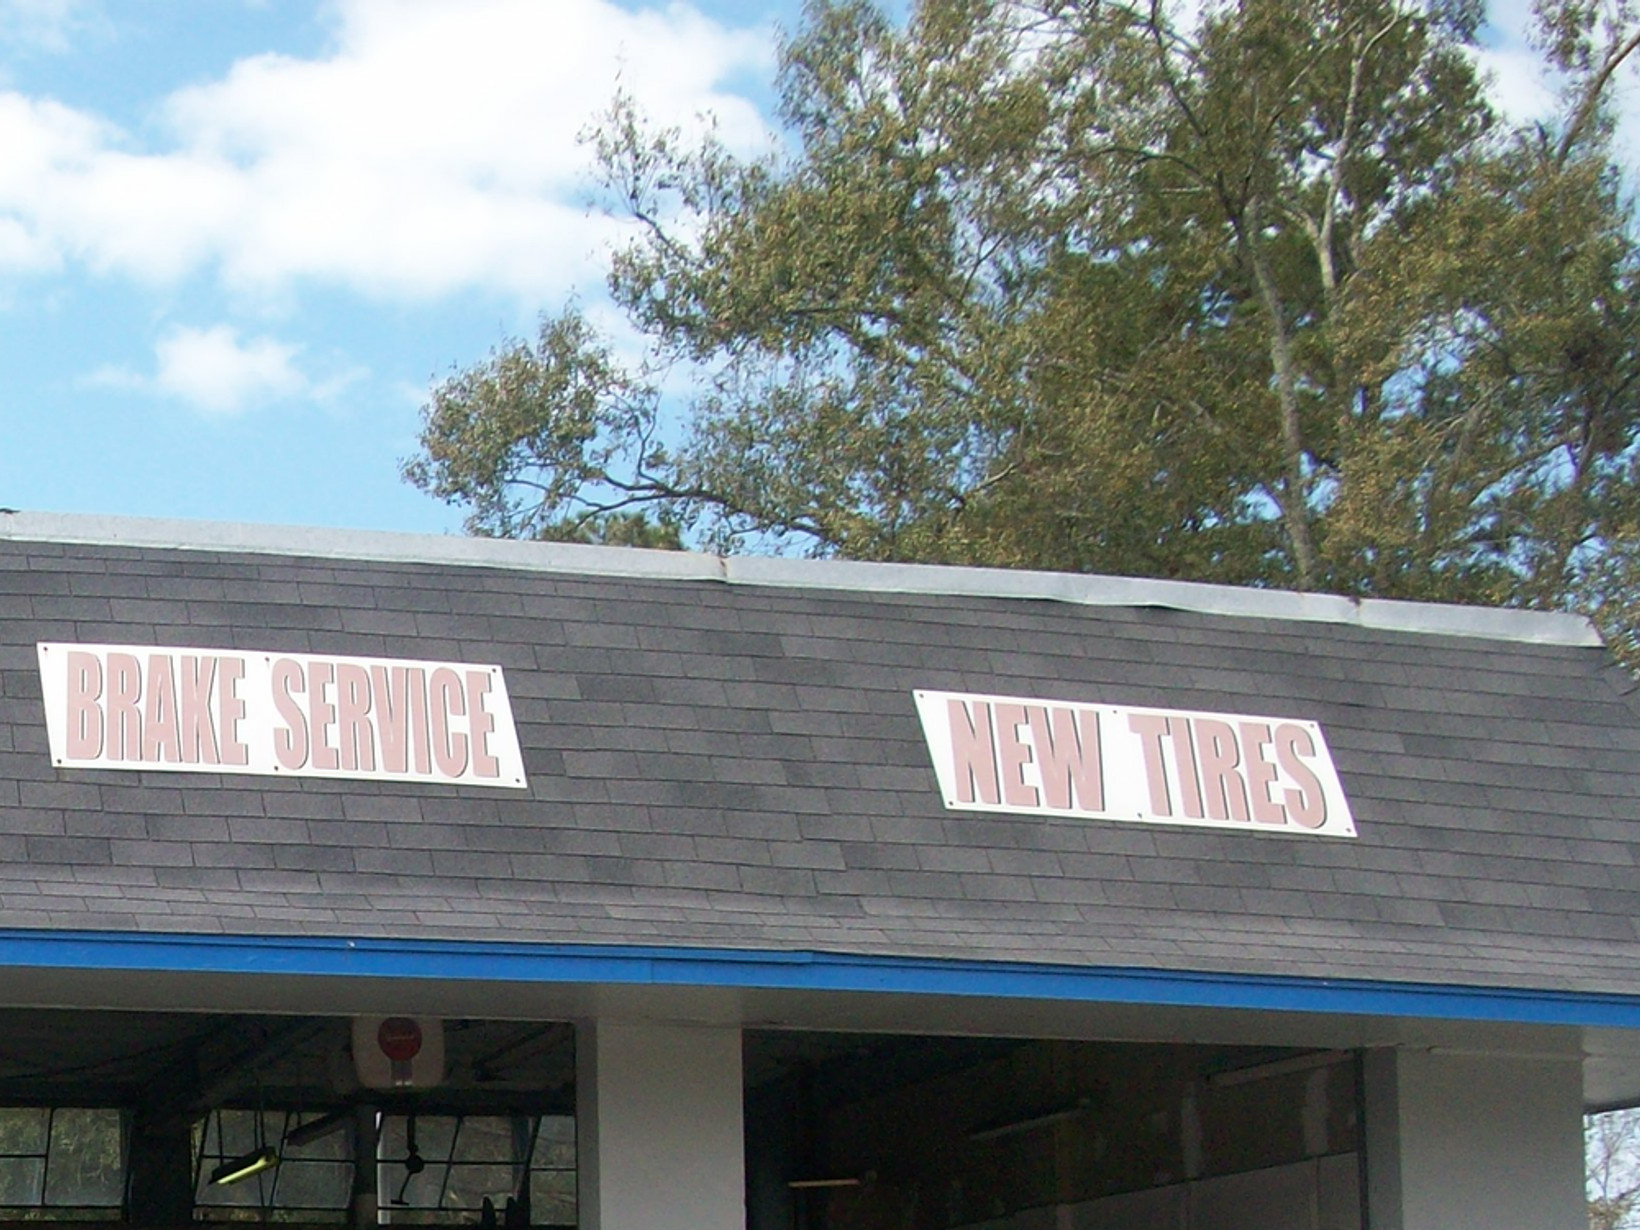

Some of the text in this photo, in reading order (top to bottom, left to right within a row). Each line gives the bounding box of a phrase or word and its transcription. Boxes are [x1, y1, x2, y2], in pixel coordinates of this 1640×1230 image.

[66, 650, 501, 779] BRAKE SERVICE
[946, 698, 1329, 830] NEW TIRES
